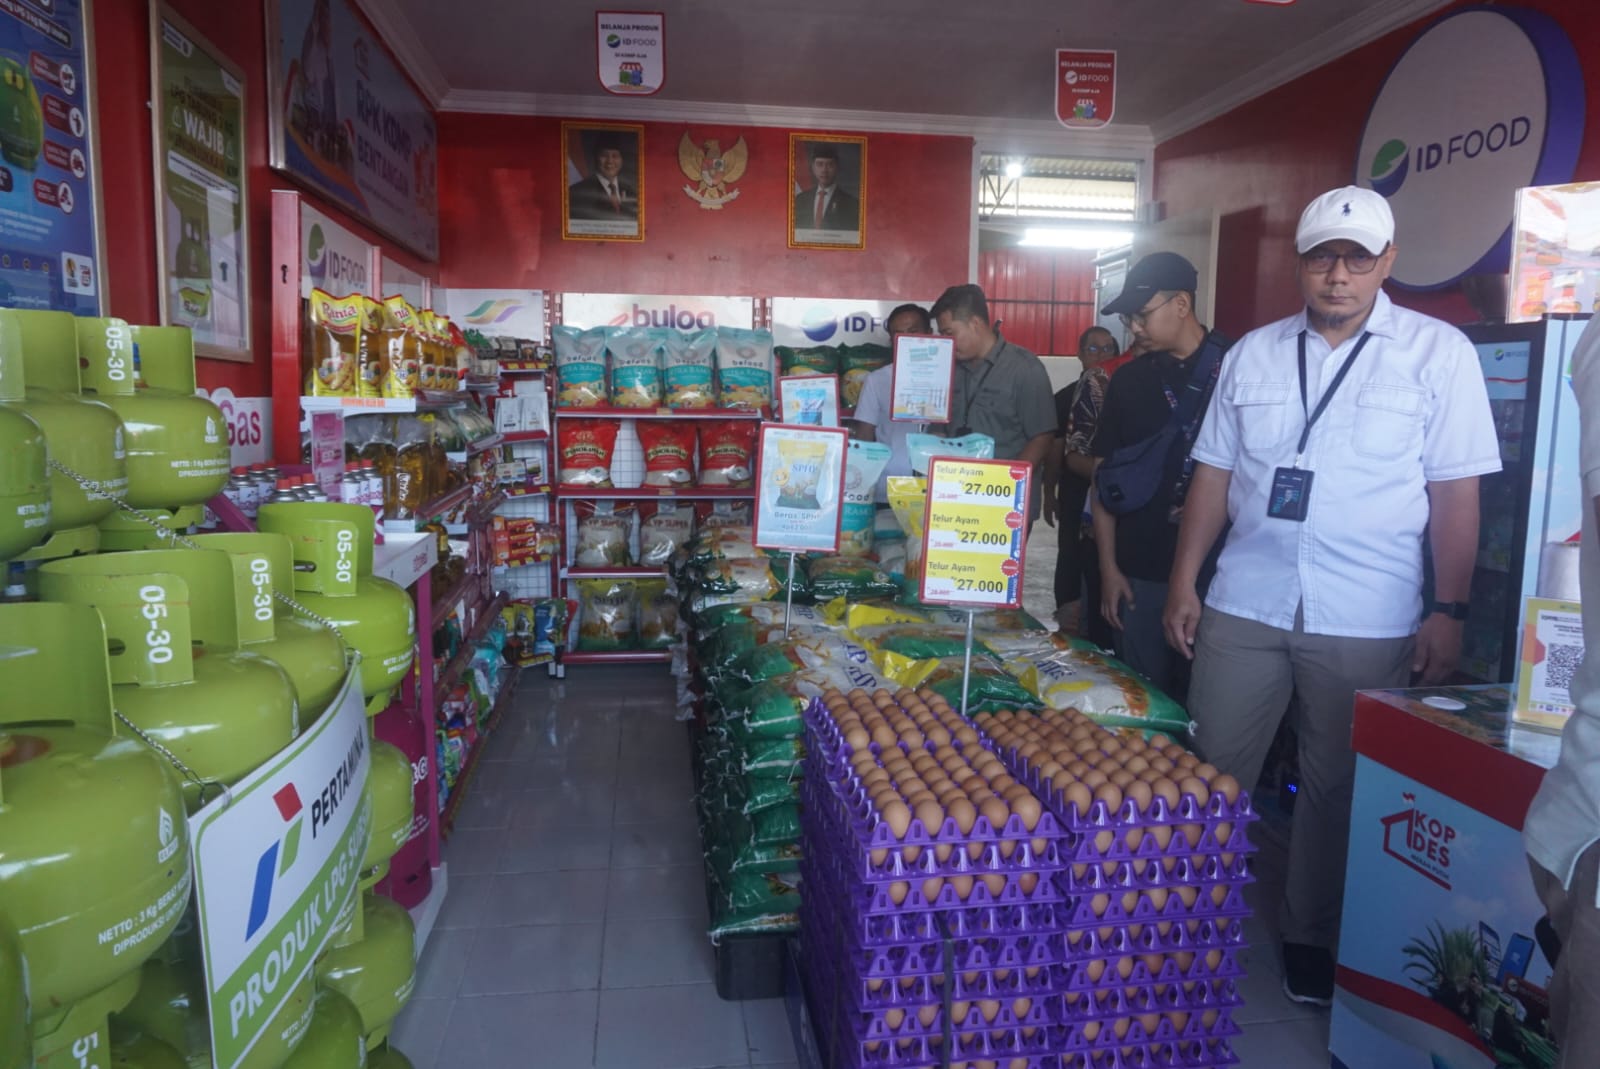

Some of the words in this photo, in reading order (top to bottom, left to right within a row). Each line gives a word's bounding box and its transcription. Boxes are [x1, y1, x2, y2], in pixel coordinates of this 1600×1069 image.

[622, 37, 632, 46] ID
[633, 38, 657, 46] FOOD
[1088, 74, 1110, 82] FOOD
[183, 107, 225, 156] WAJIB
[1416, 142, 1444, 173] ID
[1447, 116, 1532, 165] FOOD
[328, 248, 340, 280] ID
[844, 315, 867, 333] ID
[105, 326, 126, 381] 05-30
[936, 465, 957, 474] Telur
[959, 467, 984, 477] Ayam
[965, 482, 1011, 498] 27.000
[932, 514, 953, 523] Telur
[955, 515, 980, 525] Ayam
[961, 530, 1007, 546] 27.000
[336, 529, 353, 583] 05-30
[928, 562, 949, 570] Telur
[951, 563, 976, 573] Ayam
[250, 558, 273, 621] 05-30
[957, 578, 1003, 593] 27.000
[139, 585, 173, 664] 05-30
[1414, 809, 1456, 844] KOP
[1412, 830, 1450, 868] DES
[98, 918, 133, 945] NETTO
[145, 905, 157, 918] Kg
[229, 893, 322, 1040] PRODUK
[324, 852, 348, 914] LPG
